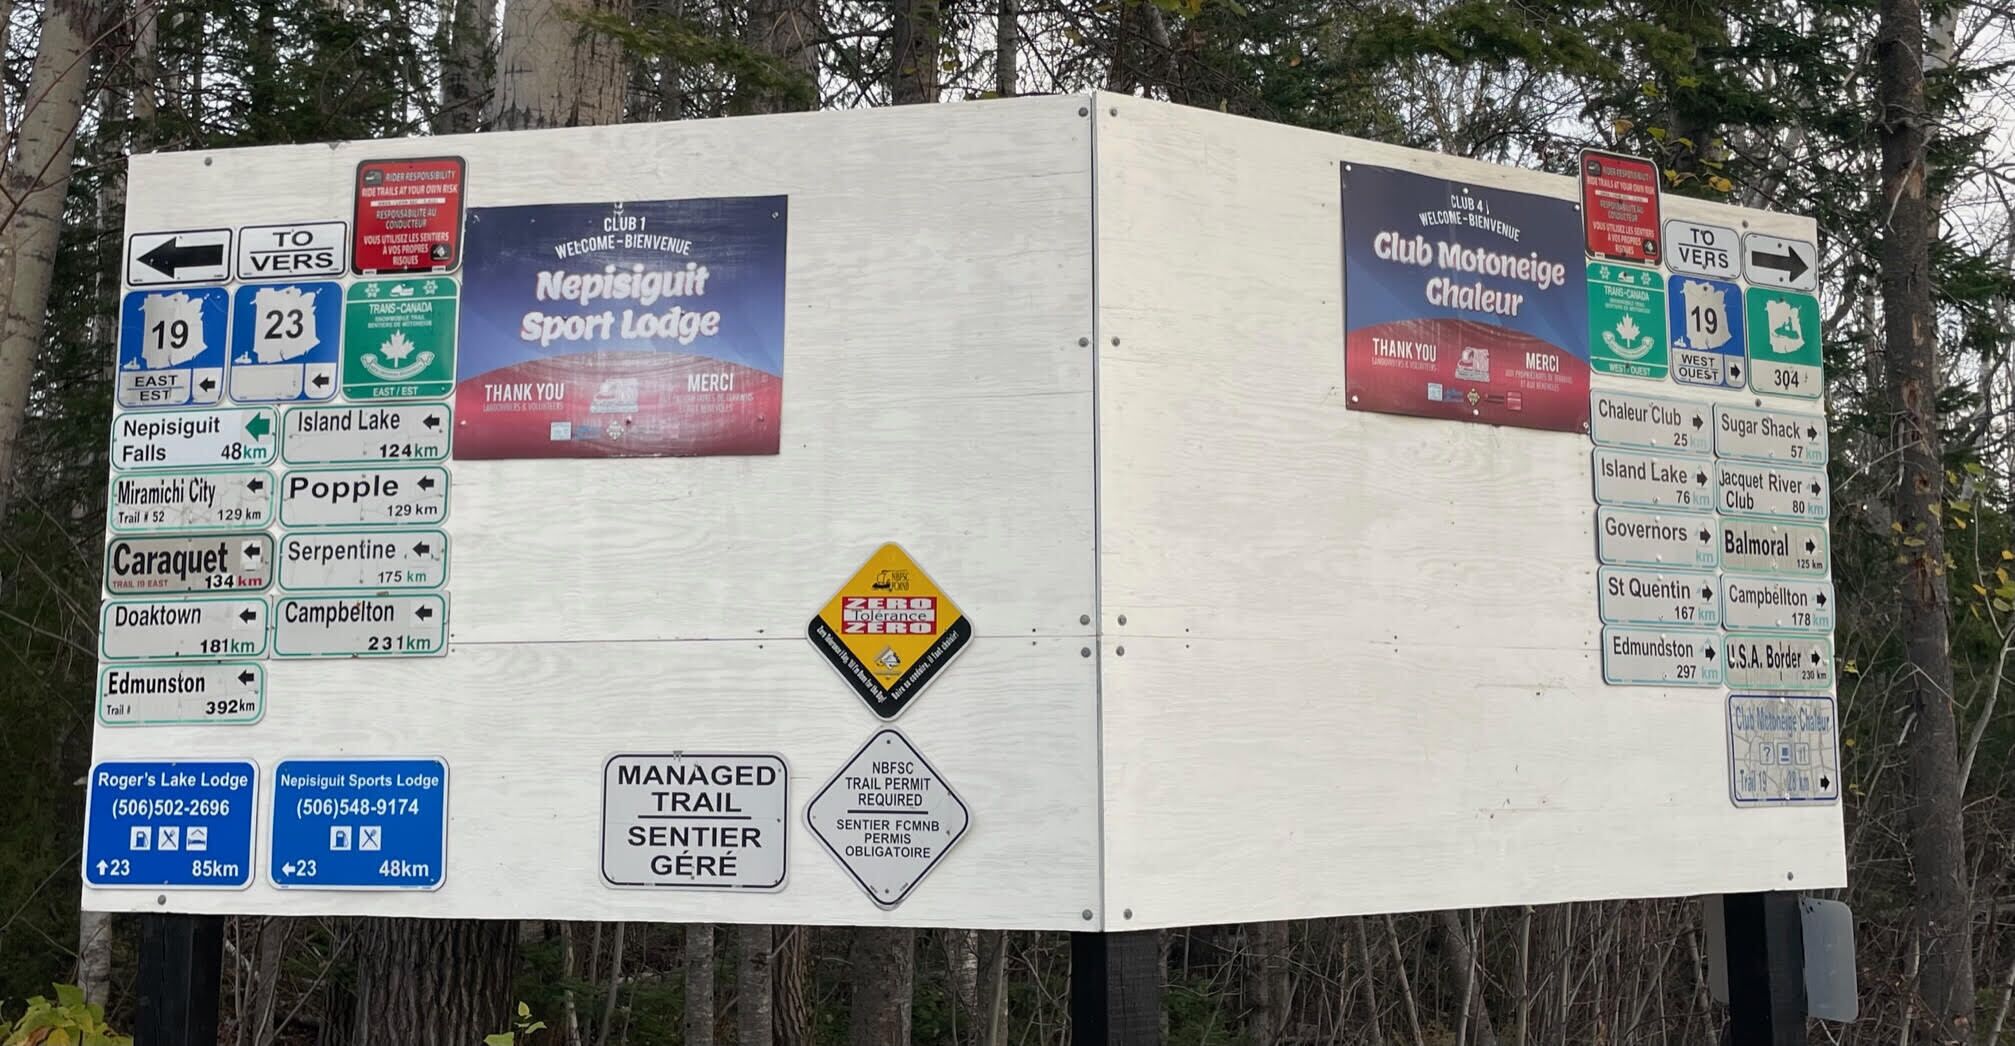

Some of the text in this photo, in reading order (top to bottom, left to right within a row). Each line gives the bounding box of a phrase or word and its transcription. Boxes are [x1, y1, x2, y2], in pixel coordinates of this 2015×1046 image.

[362, 184, 458, 196] RIDE TRAILS AT YOUR OWN RISK
[1451, 195, 1483, 212] CLUB 4
[604, 216, 646, 232] CLUB 1
[273, 231, 313, 247] TO
[364, 232, 449, 244] VOUS UTILISEZ LES SENTIERS
[1690, 228, 1714, 245] TO
[388, 245, 400, 254] VOS
[402, 244, 428, 253] PROPRES
[251, 253, 334, 272] VERS
[393, 256, 418, 265] RISQUES
[1374, 232, 1565, 289] Club Motoneige
[1679, 248, 1728, 268] VERS
[537, 262, 710, 306] Nepisiguit
[1426, 277, 1524, 316] Chaleur
[369, 302, 432, 314] TRANS-CANADA
[265, 309, 304, 340] 23
[521, 306, 721, 346] Sport Lodge
[1691, 306, 1717, 333] 19
[152, 320, 189, 350] 19
[1372, 338, 1436, 362] THANK YOU
[1526, 352, 1559, 372] MERCI
[1682, 354, 1715, 367] WEST
[1609, 364, 1650, 375] WEST OUEST
[1679, 368, 1719, 380] OUEST
[135, 376, 178, 388] EAST
[688, 373, 734, 392] MERCI
[1774, 369, 1799, 388] 304
[140, 390, 170, 400] EST
[373, 386, 418, 396] EAST EST
[485, 383, 564, 402] THANK YOU
[298, 408, 400, 432] Island Lake
[1599, 399, 1681, 425] Chaleur Club
[123, 417, 220, 439] Nepisiguit
[1722, 413, 1800, 439] Sugar Shack
[1674, 433, 1706, 447] 25 km
[122, 445, 166, 462] Falls
[1791, 446, 1822, 460] 57 km
[1601, 458, 1687, 484] Island Lake
[289, 475, 399, 503] Popple
[1719, 470, 1802, 493] Jacquet River
[118, 477, 216, 508] Miramichi City
[1676, 491, 1710, 504] 76 km
[1726, 491, 1754, 509] Club
[218, 508, 261, 521] 129 km
[387, 504, 437, 516] 129 km
[1793, 501, 1823, 514] 80 km
[118, 511, 165, 524] Trail 52
[1605, 518, 1687, 541] Governors
[1725, 530, 1788, 556] Balmoral
[288, 541, 395, 564] Serpentine
[1696, 550, 1714, 562] km
[114, 542, 228, 581] Caraquet
[1797, 560, 1822, 569] 125 km
[113, 580, 136, 588] TRAIL
[148, 579, 168, 587] EAST
[205, 574, 262, 588] 134 km
[379, 571, 426, 583] 175 km
[1608, 577, 1690, 599] St Quentin
[1729, 585, 1807, 608] Campbellton
[845, 598, 931, 609] ZERO
[116, 606, 200, 626] Doaktown
[285, 601, 394, 628] Campbelton
[854, 610, 926, 621] Tolérance
[1675, 607, 1716, 620] 167 km
[1792, 614, 1828, 626] 178 km
[844, 622, 931, 633] ZERO
[1614, 636, 1693, 657] Edmundston
[1727, 644, 1800, 668] U.S.A. Border
[1677, 665, 1718, 679] 297 km
[1802, 671, 1826, 680] 230 km
[109, 671, 205, 695] Edmunston
[107, 704, 124, 716] Trail
[1736, 706, 1754, 730] Club
[618, 765, 776, 785] MANAGED
[873, 762, 913, 774] NBFSC
[98, 772, 248, 791] Roger's Lake Lodge
[281, 774, 439, 790] Nepisiguit Sports Lodge
[846, 778, 930, 790] TRAIL PERMIT
[652, 792, 742, 812] TRAIL
[859, 793, 922, 806] REQUIRED
[112, 799, 229, 819] (506)502-2696
[297, 799, 419, 819] (506)548-9174
[837, 820, 939, 832] SENTIER FCMNB
[628, 827, 761, 848] SENTIER
[864, 833, 911, 844] PERMIS
[845, 846, 931, 858] OBLIGATOIRE
[110, 860, 130, 875] 23
[192, 860, 238, 876] 85km
[296, 860, 316, 876] 23
[379, 860, 428, 876] 48km
[650, 851, 736, 877] GÉRÉ
